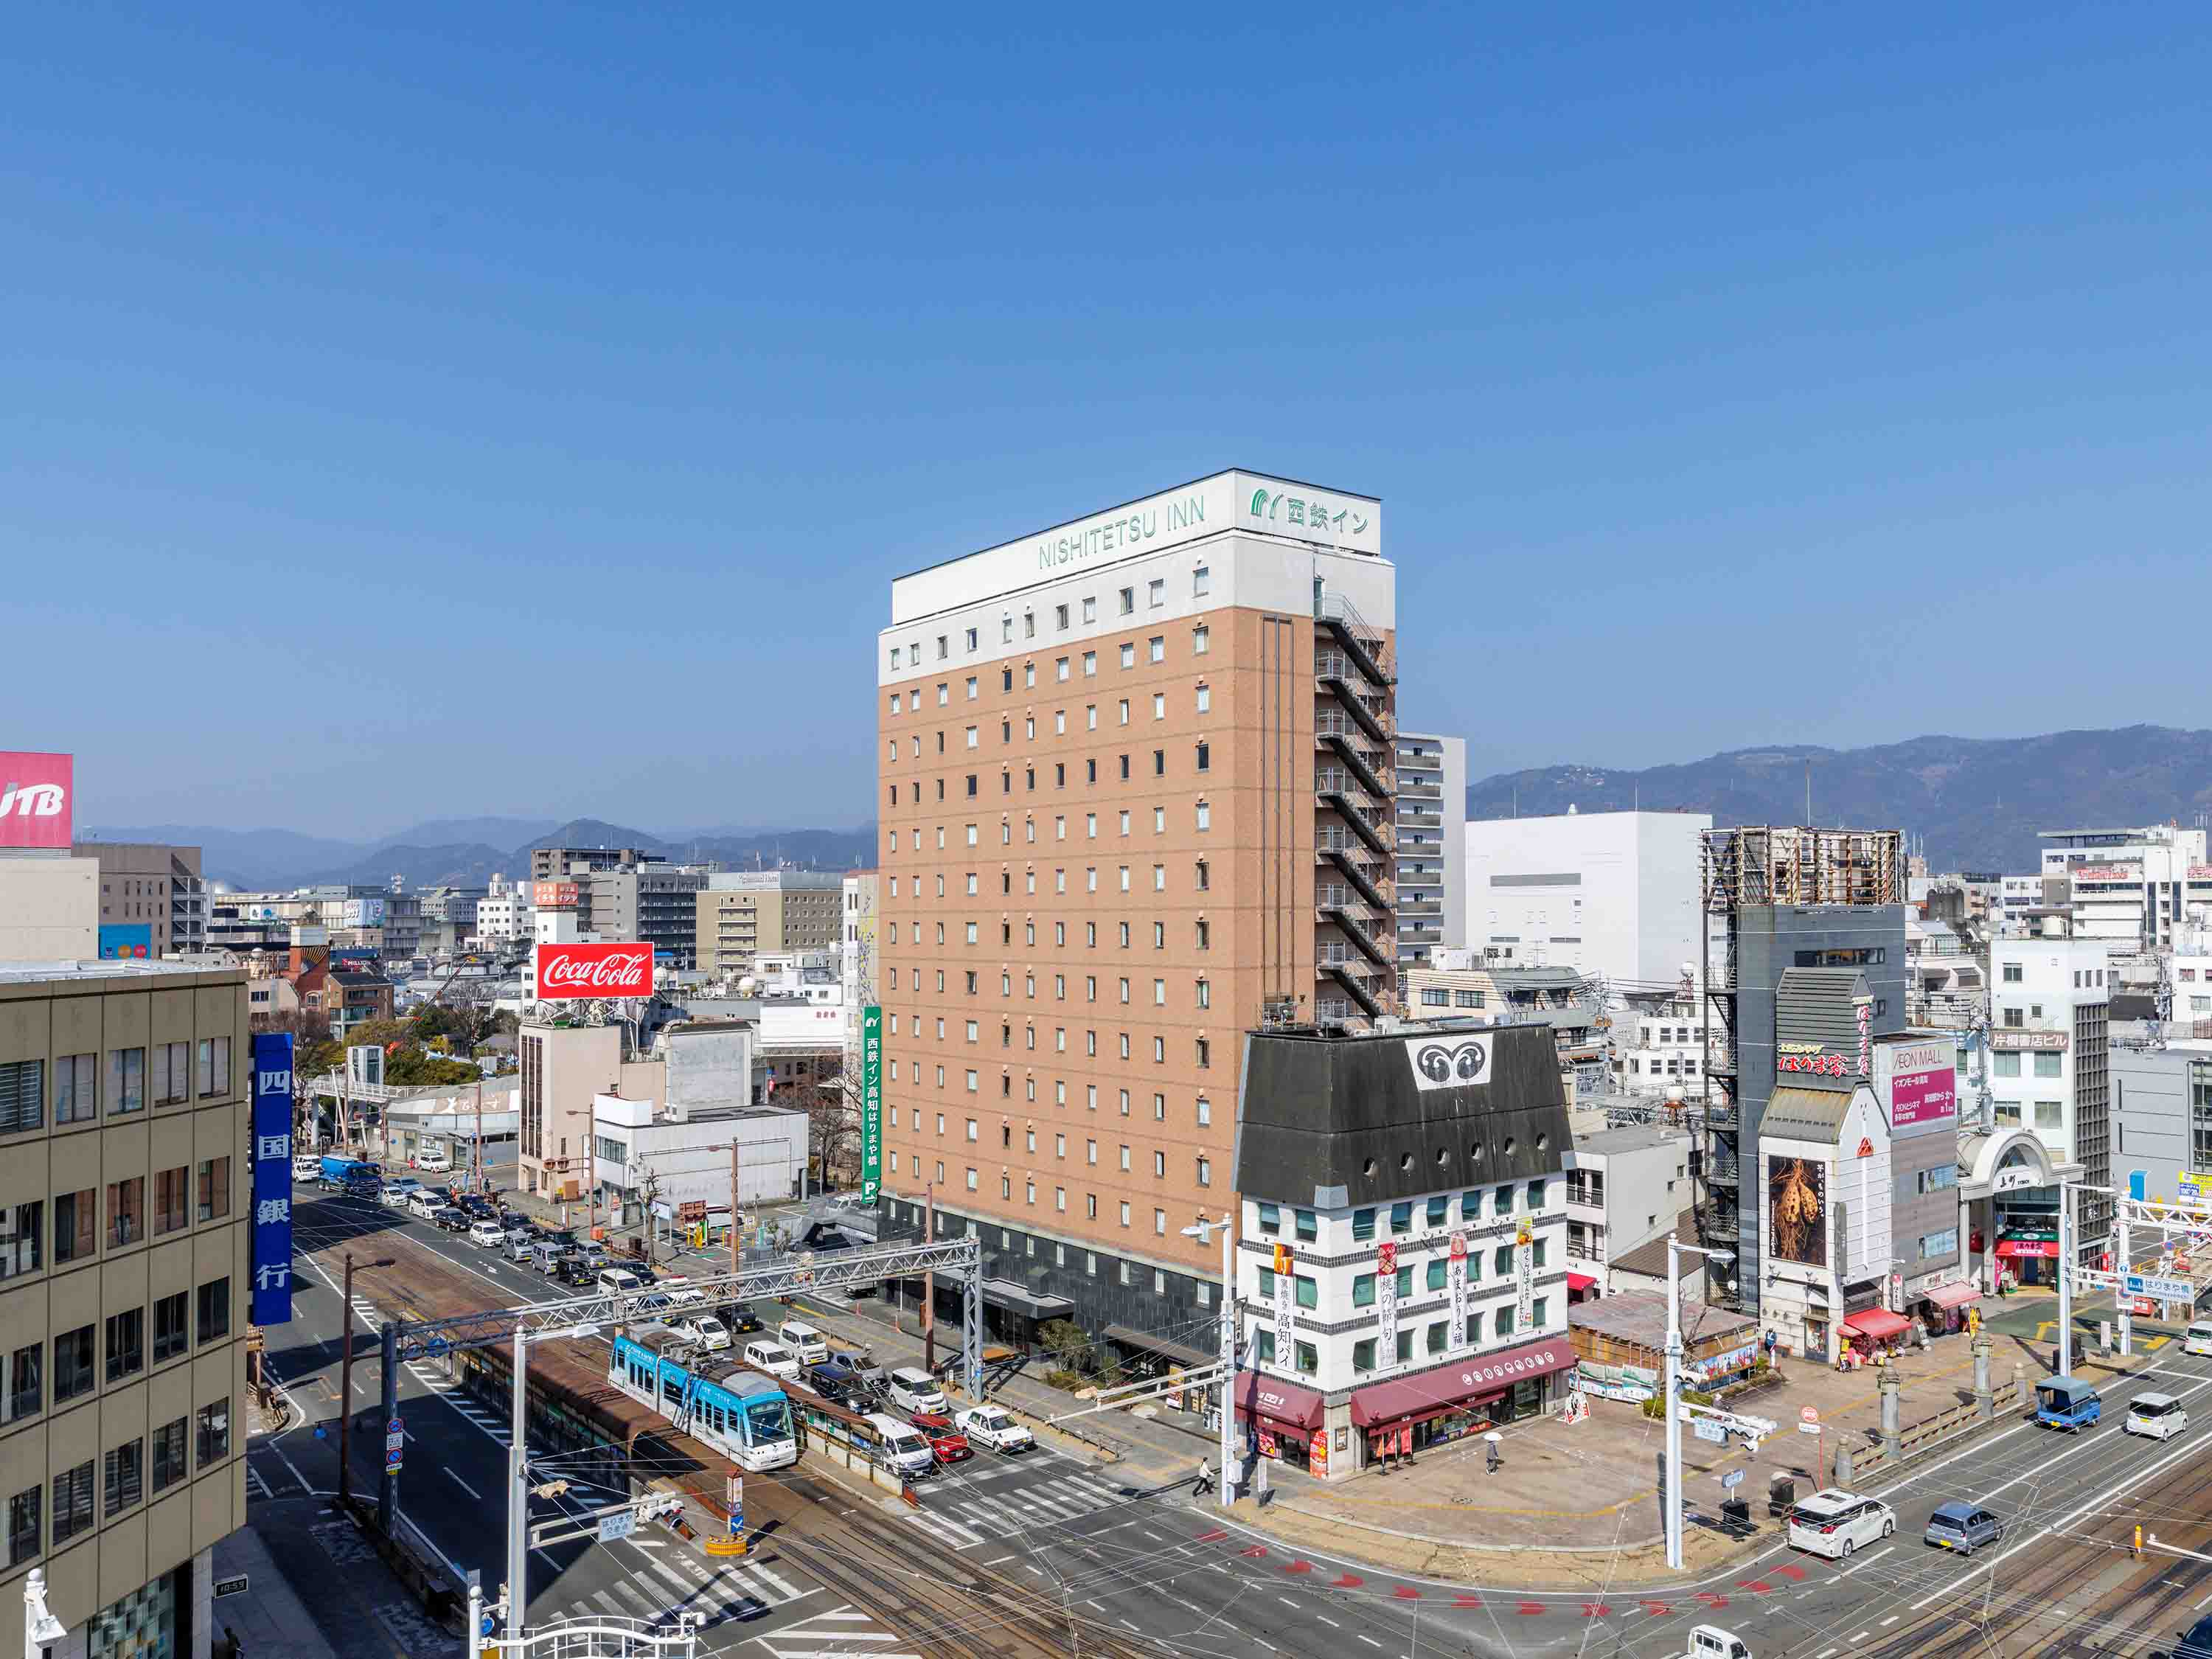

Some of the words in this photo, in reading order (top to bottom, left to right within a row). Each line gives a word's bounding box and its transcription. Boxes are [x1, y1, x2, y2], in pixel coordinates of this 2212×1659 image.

[1038, 509, 1156, 570] NISHITETSU
[1166, 495, 1206, 532] INN
[1286, 497, 1369, 535] 西鉄イン
[543, 953, 650, 988] Coca-Cola
[1778, 1054, 1849, 1079] はりま家
[1919, 1049, 1943, 1066] MALL
[867, 1038, 879, 1166] 西鉄イン高知はりまや橋
[256, 1069, 291, 1290] 四国銀行
